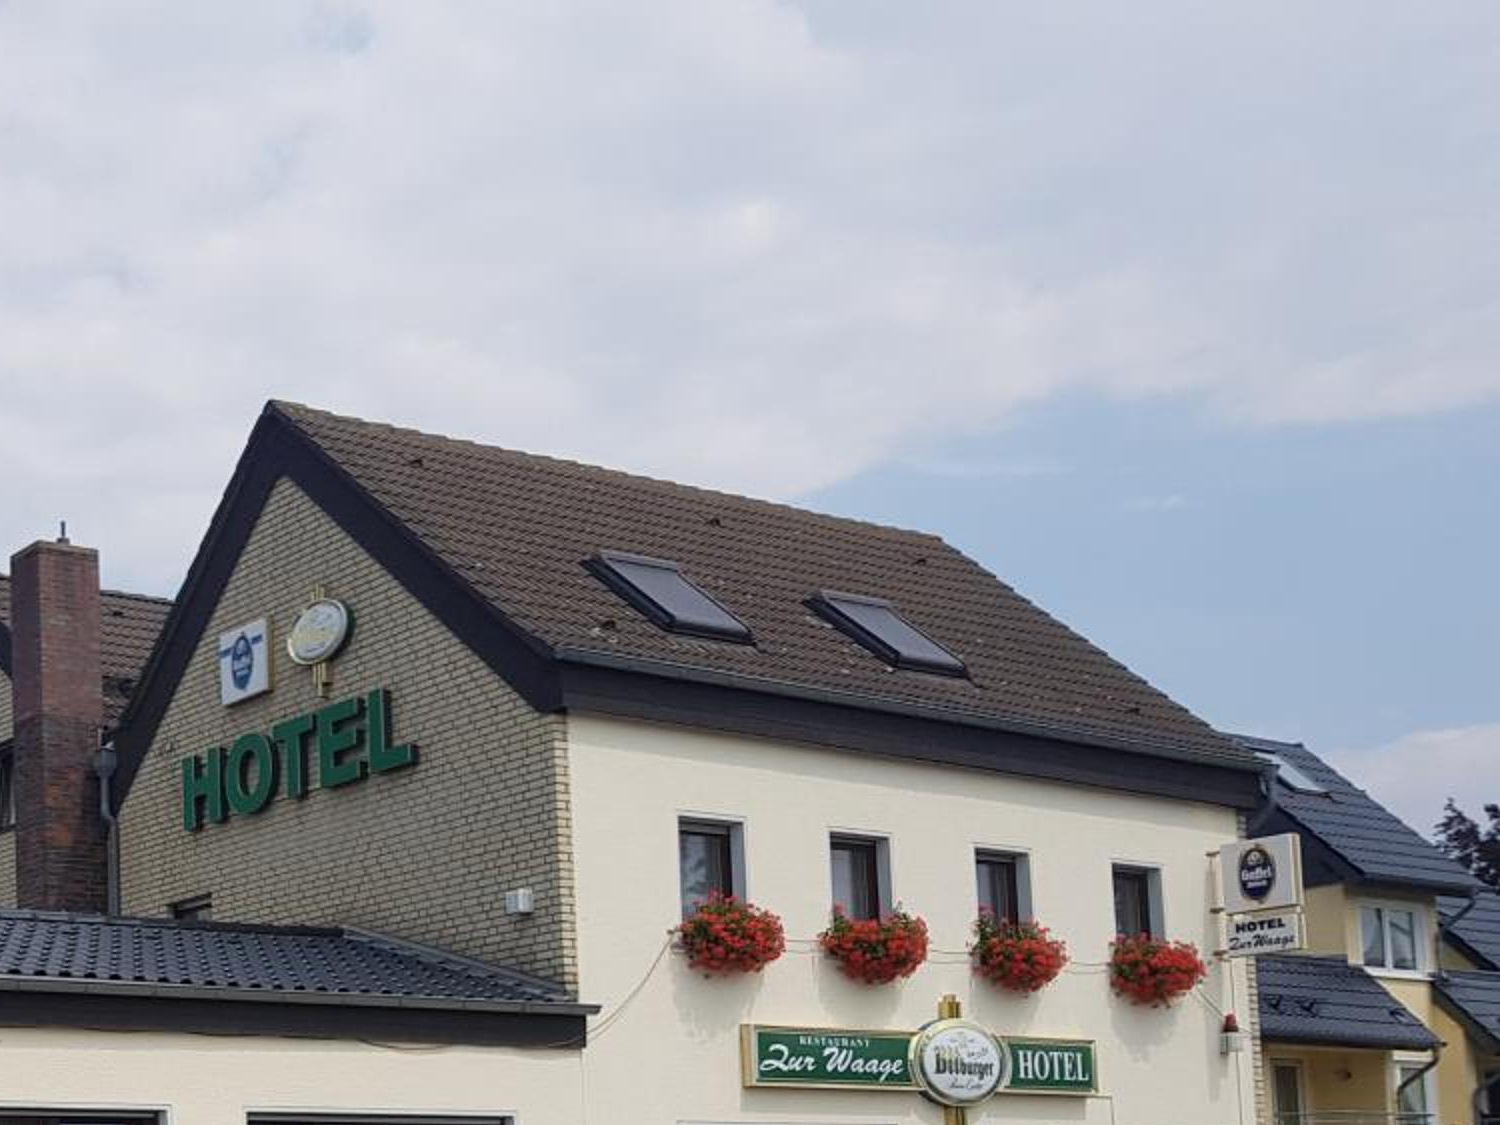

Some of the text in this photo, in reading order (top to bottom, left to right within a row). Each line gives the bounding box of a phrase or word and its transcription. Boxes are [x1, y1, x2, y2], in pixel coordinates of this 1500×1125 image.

[181, 687, 418, 832] HOTEL
[1235, 918, 1285, 933] HOTEL
[799, 1035, 870, 1047] RESTAURANT
[759, 1043, 905, 1083] Zur Waage
[1017, 1049, 1089, 1082] HOTEL
